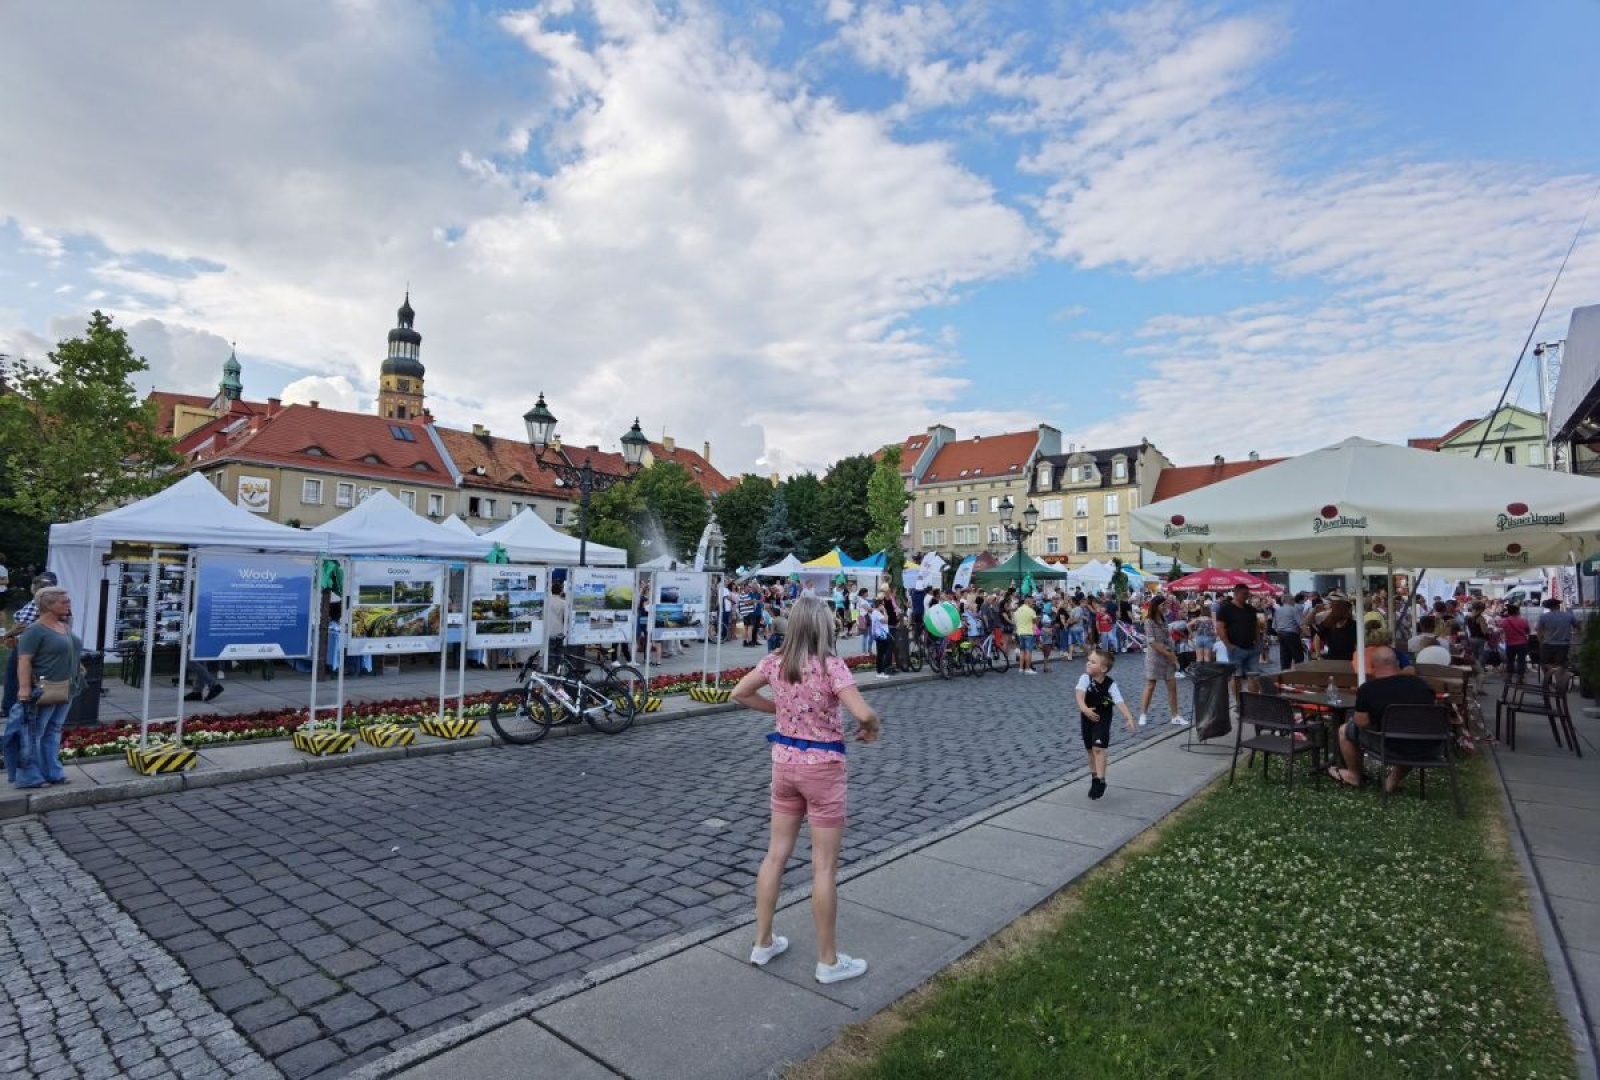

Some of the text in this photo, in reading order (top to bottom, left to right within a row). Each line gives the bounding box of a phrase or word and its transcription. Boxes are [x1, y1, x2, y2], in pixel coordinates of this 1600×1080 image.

[1496, 511, 1565, 531] Pilsner Urquell
[239, 568, 277, 582] Wody
